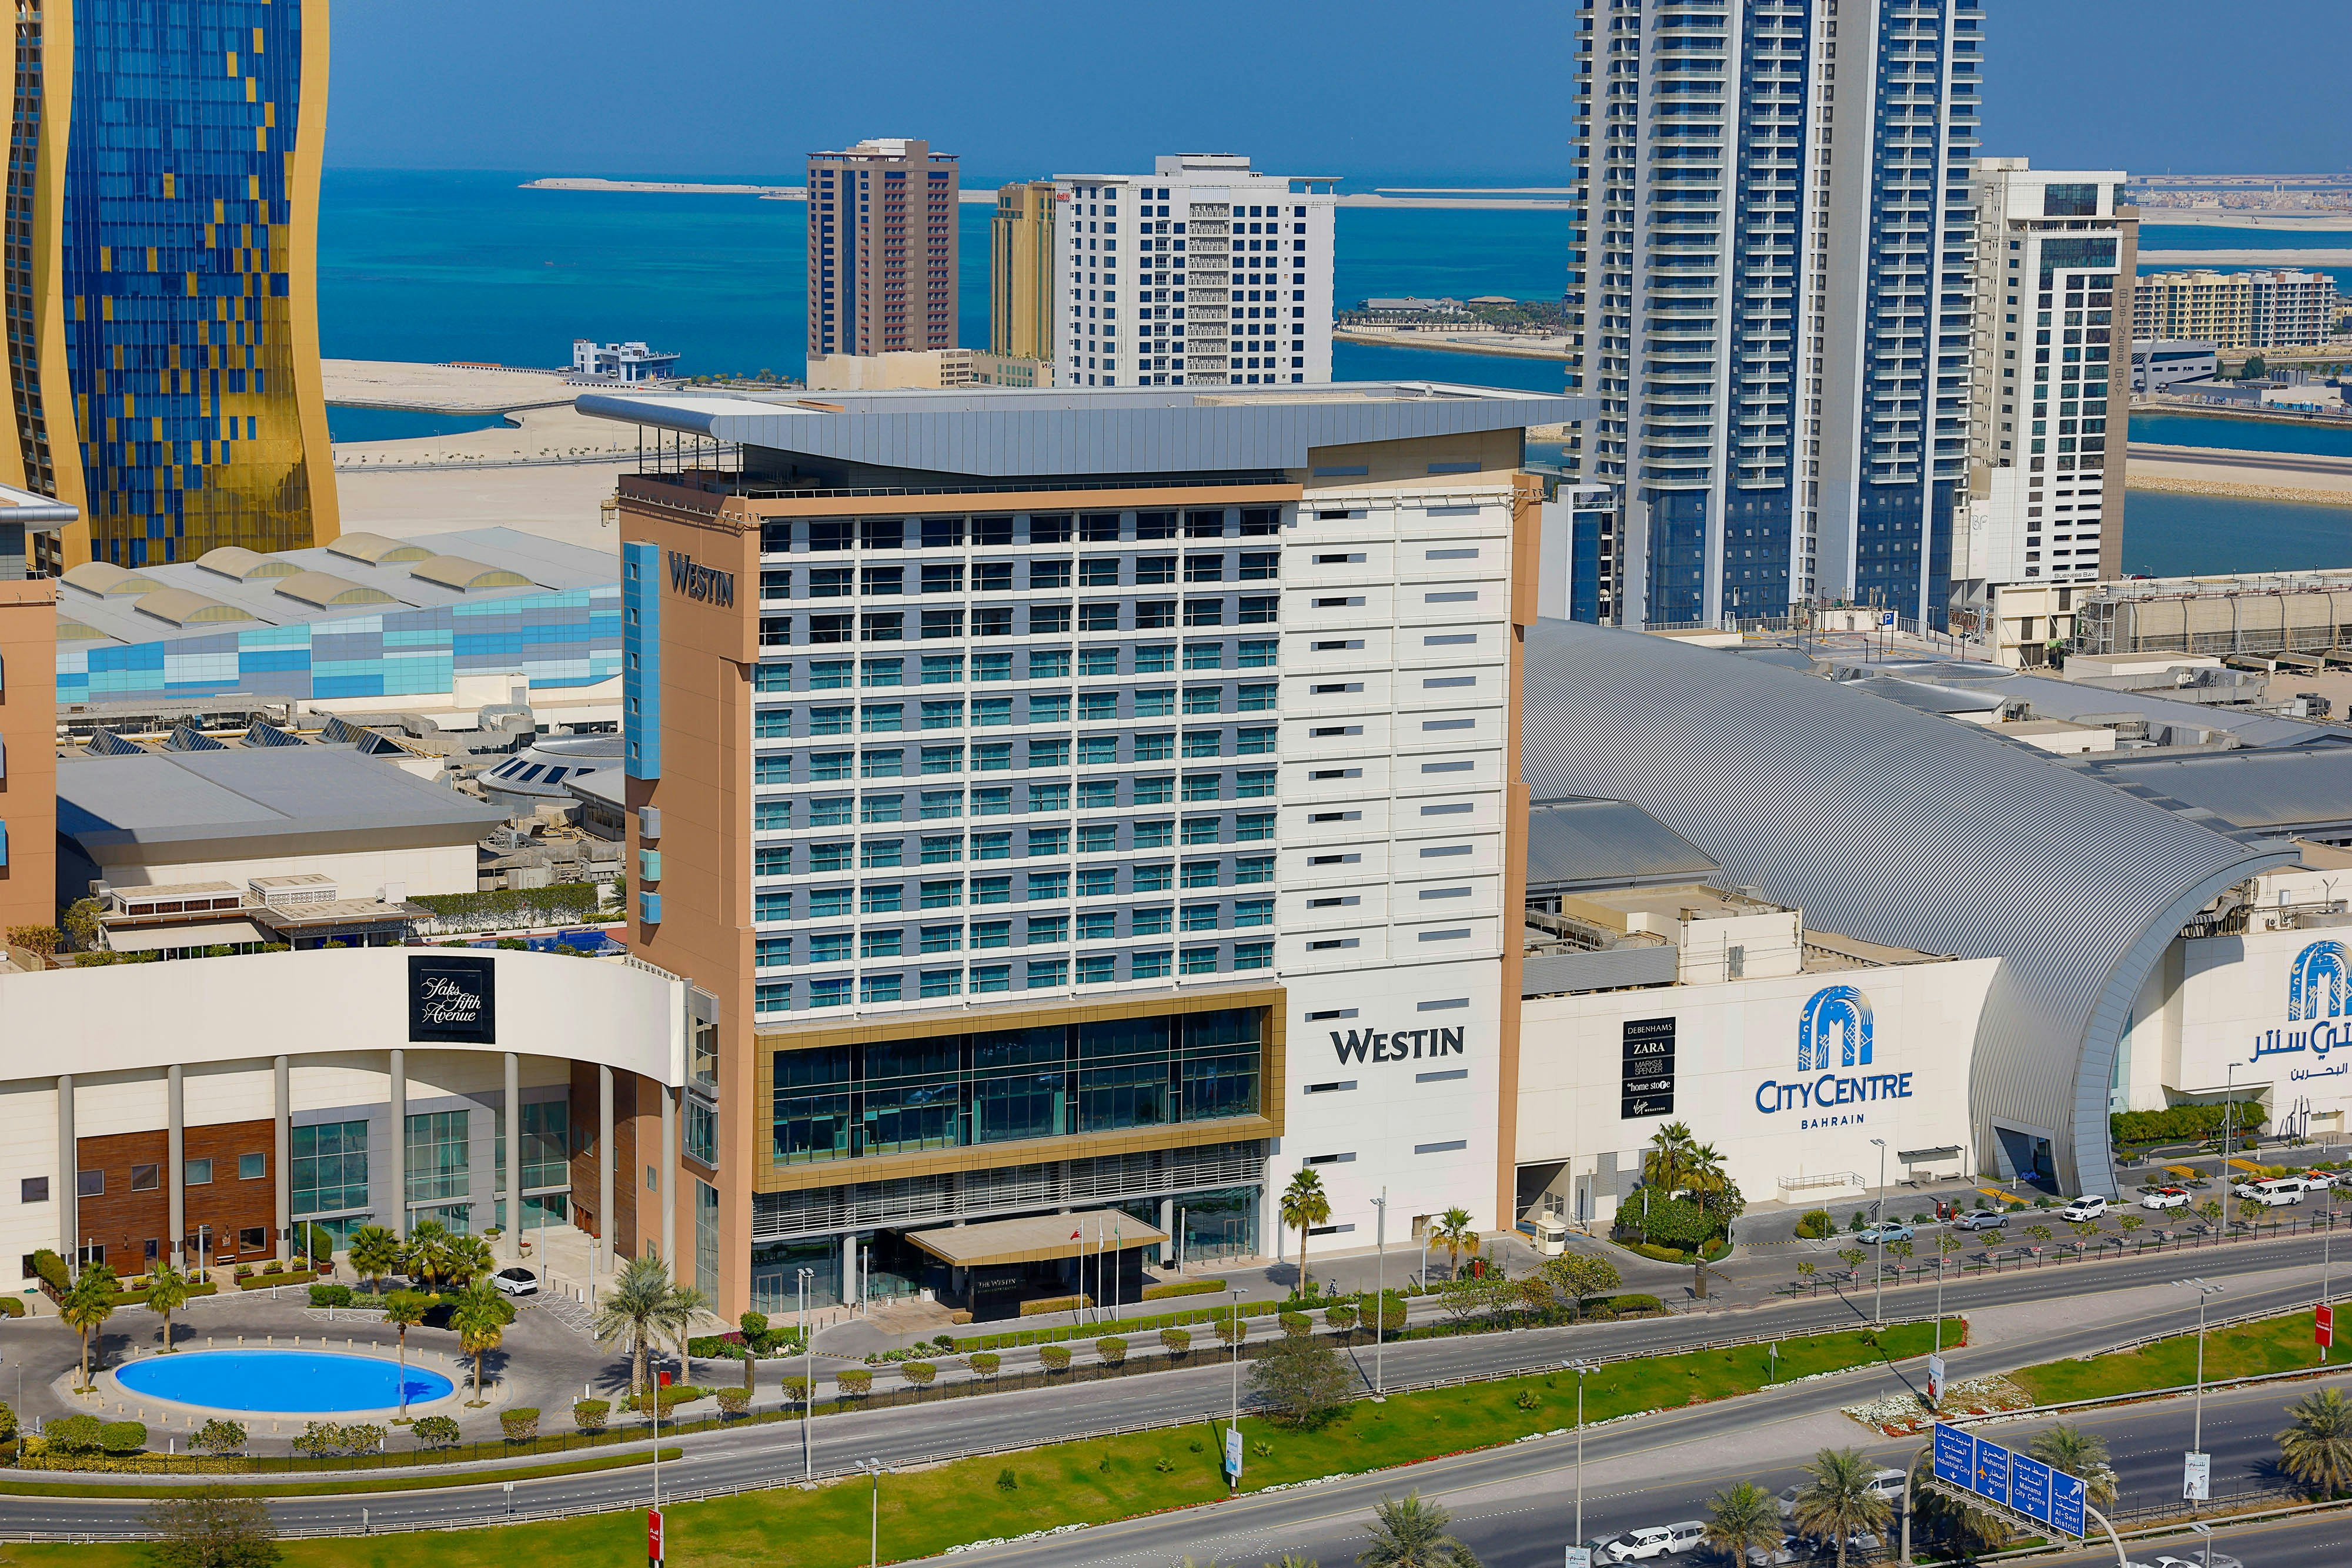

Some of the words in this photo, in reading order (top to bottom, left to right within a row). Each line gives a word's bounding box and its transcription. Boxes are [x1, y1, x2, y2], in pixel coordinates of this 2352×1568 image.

[2117, 289, 2128, 362] BUSINESS
[2115, 369, 2124, 396] BAY
[668, 550, 734, 609] WESTIN
[1885, 614, 1892, 624] P
[421, 978, 460, 999] Saks
[422, 1002, 476, 1023] Avenue
[1628, 1024, 1672, 1035] DEBENHAMS
[1329, 1026, 1465, 1065] WESTIN
[1633, 1042, 1665, 1055] ZARA
[2249, 1029, 2307, 1063] سنتر
[1635, 1066, 1663, 1075] SPENCER
[2291, 1063, 2348, 1081] البحرين
[1631, 1082, 1649, 1092] home
[1650, 1081, 1671, 1090] store
[1633, 1099, 1648, 1115] Virgin
[1801, 1114, 1865, 1129] BAHRAIN
[991, 1278, 1016, 1286] WESTIN
[1937, 1429, 1955, 1440] سلمان
[1956, 1435, 1971, 1447] مدينة
[1941, 1440, 1966, 1456] الصناعية
[1983, 1447, 2006, 1460] المحرق
[1945, 1452, 1963, 1463] Salman
[1983, 1456, 2006, 1472] Muharraq
[1937, 1456, 1959, 1470] Industrial
[1960, 1465, 1970, 1476] City
[2014, 1459, 2030, 1472] مدينة
[2032, 1466, 2048, 1480] وسط
[1989, 1469, 2006, 1480] المطار
[2019, 1472, 2042, 1487] المنامة
[1988, 1477, 2005, 1489] Airport
[2019, 1482, 2042, 1496] Manama
[2014, 1488, 2025, 1499] City
[2027, 1493, 2046, 1506] Centre
[2054, 1489, 2080, 1505] ضاحية
[2055, 1500, 2079, 1513] السيف
[2055, 1509, 2079, 1524] Al-Seef
[2055, 1517, 2079, 1533] District
